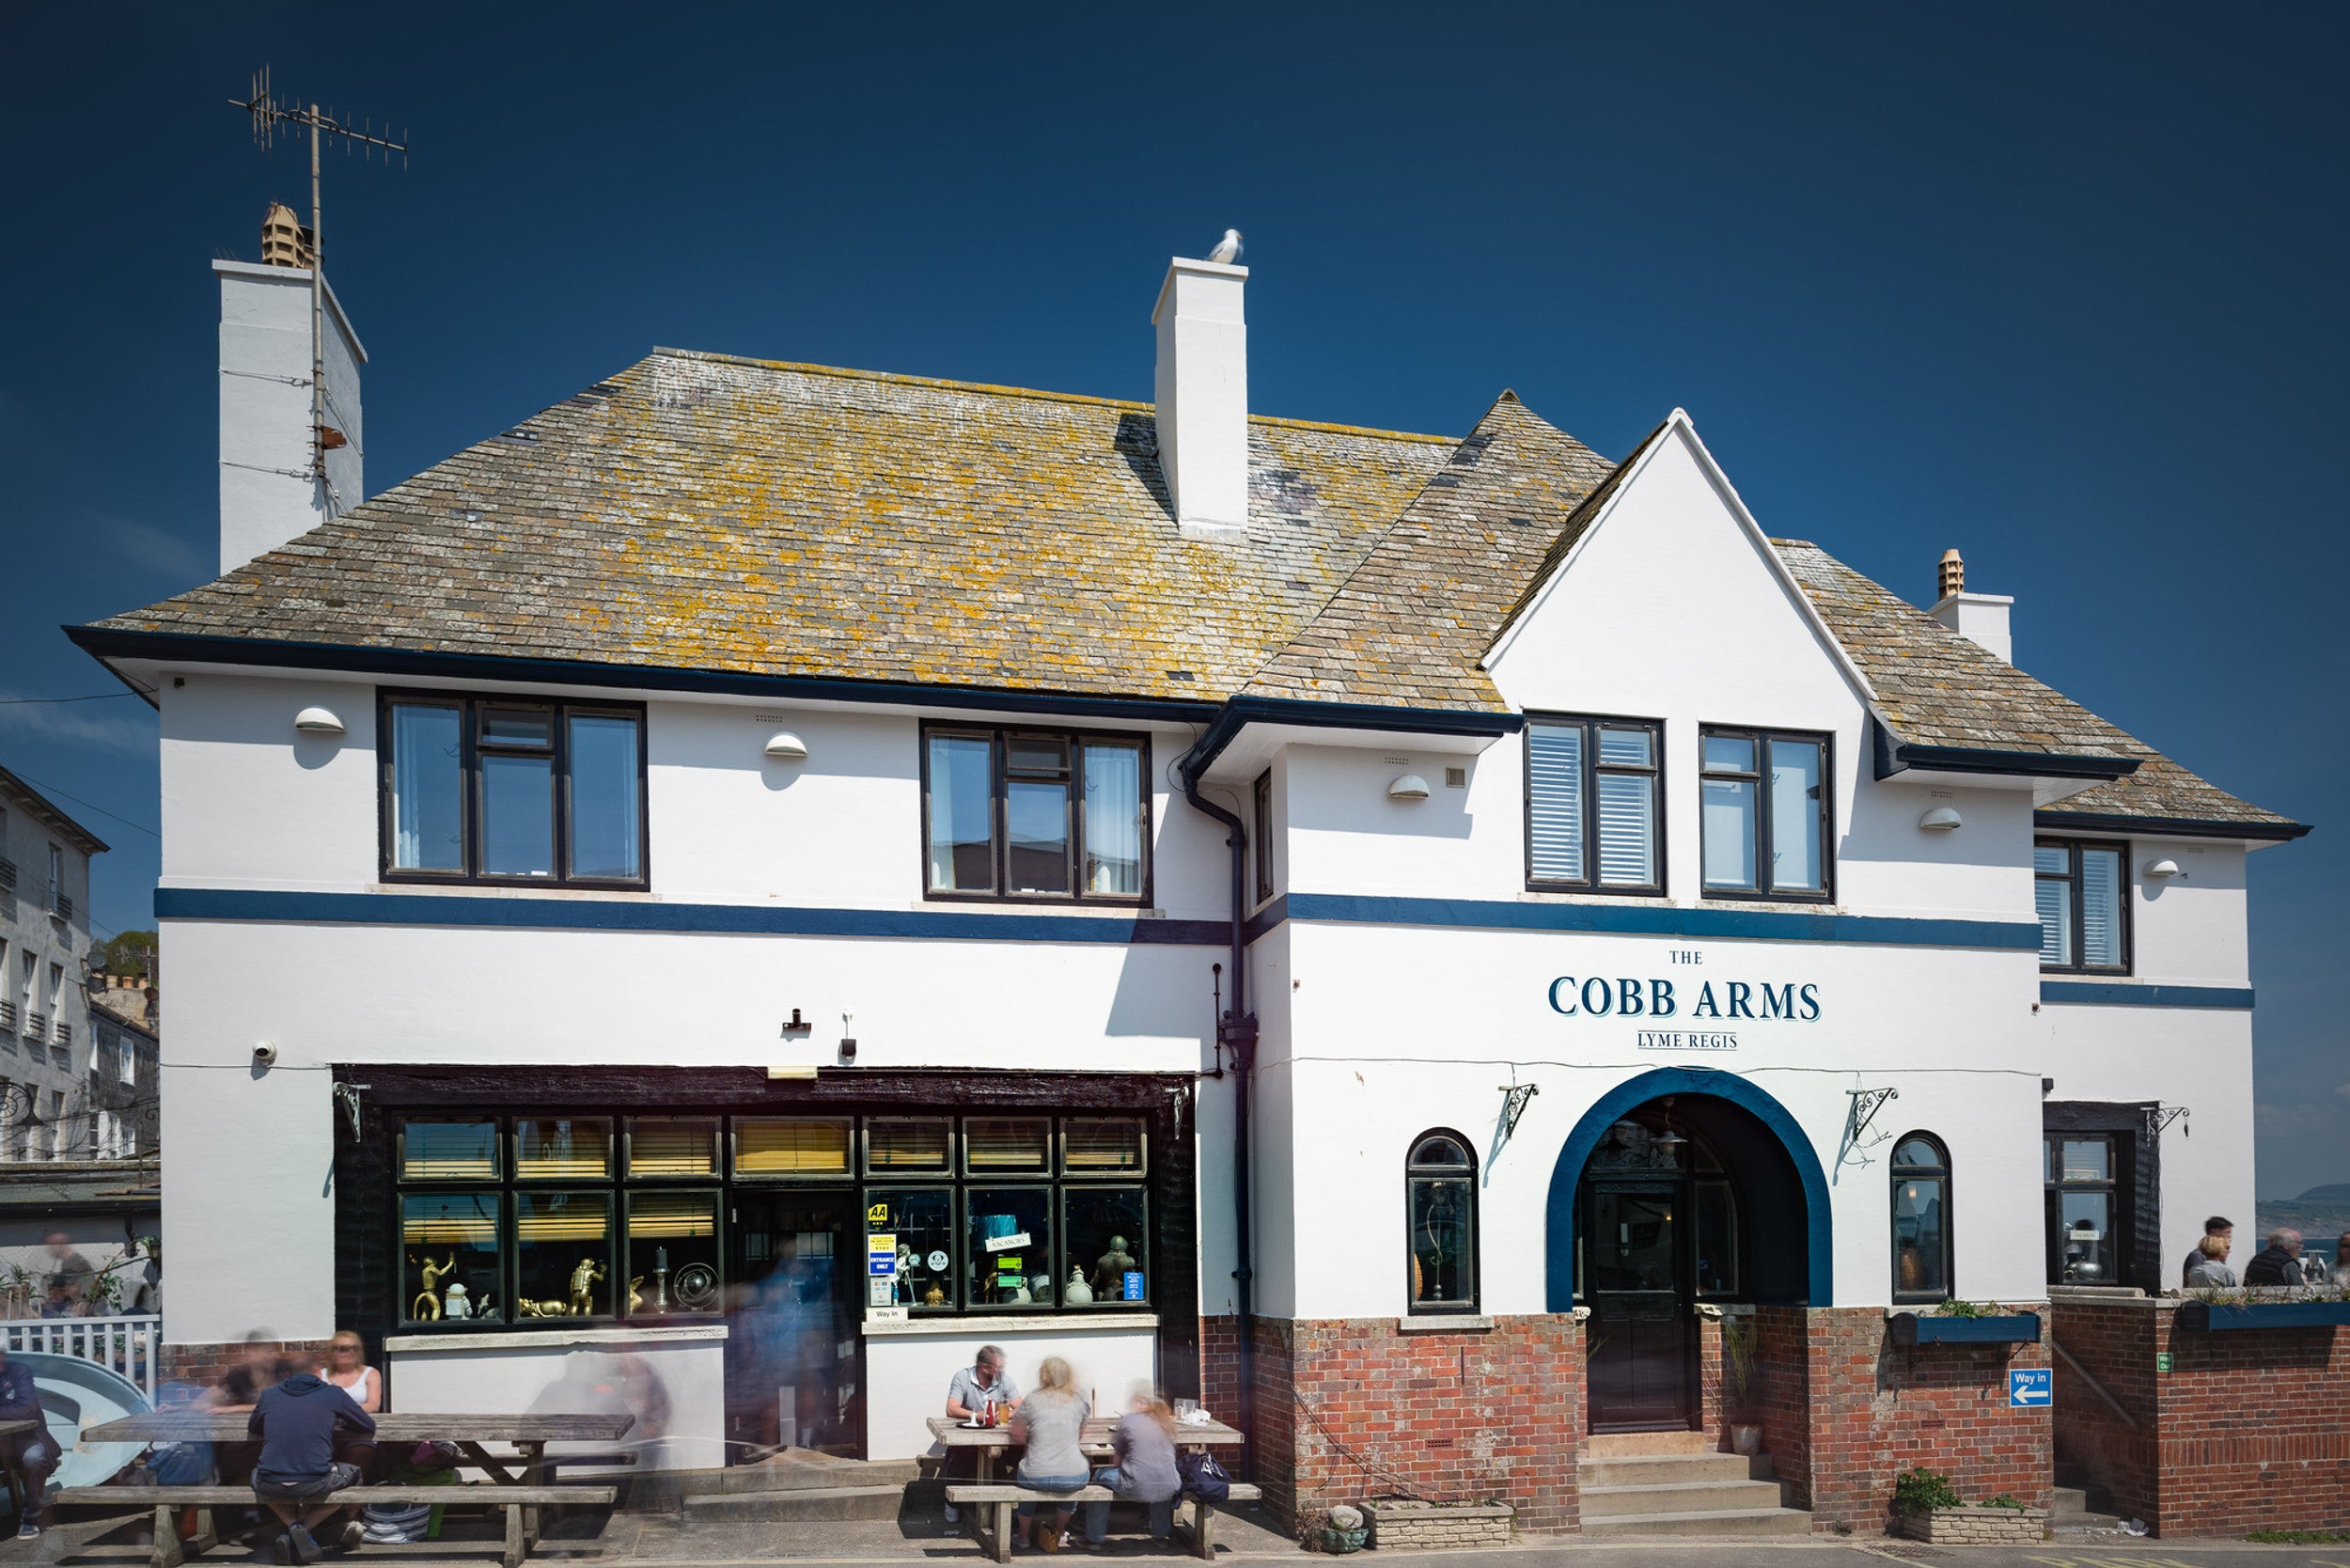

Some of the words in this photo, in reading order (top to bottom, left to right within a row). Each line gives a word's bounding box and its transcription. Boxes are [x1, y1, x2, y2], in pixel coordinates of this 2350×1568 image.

[1669, 949, 1702, 964] THE
[1548, 976, 1677, 1018] COBB
[1692, 980, 1822, 1023] ARMS
[1637, 1032, 1683, 1047] LYME
[1688, 1033, 1738, 1049] REGIS
[870, 1206, 886, 1217] AA
[2014, 1373, 2035, 1385] Way
[2037, 1372, 2046, 1382] in
